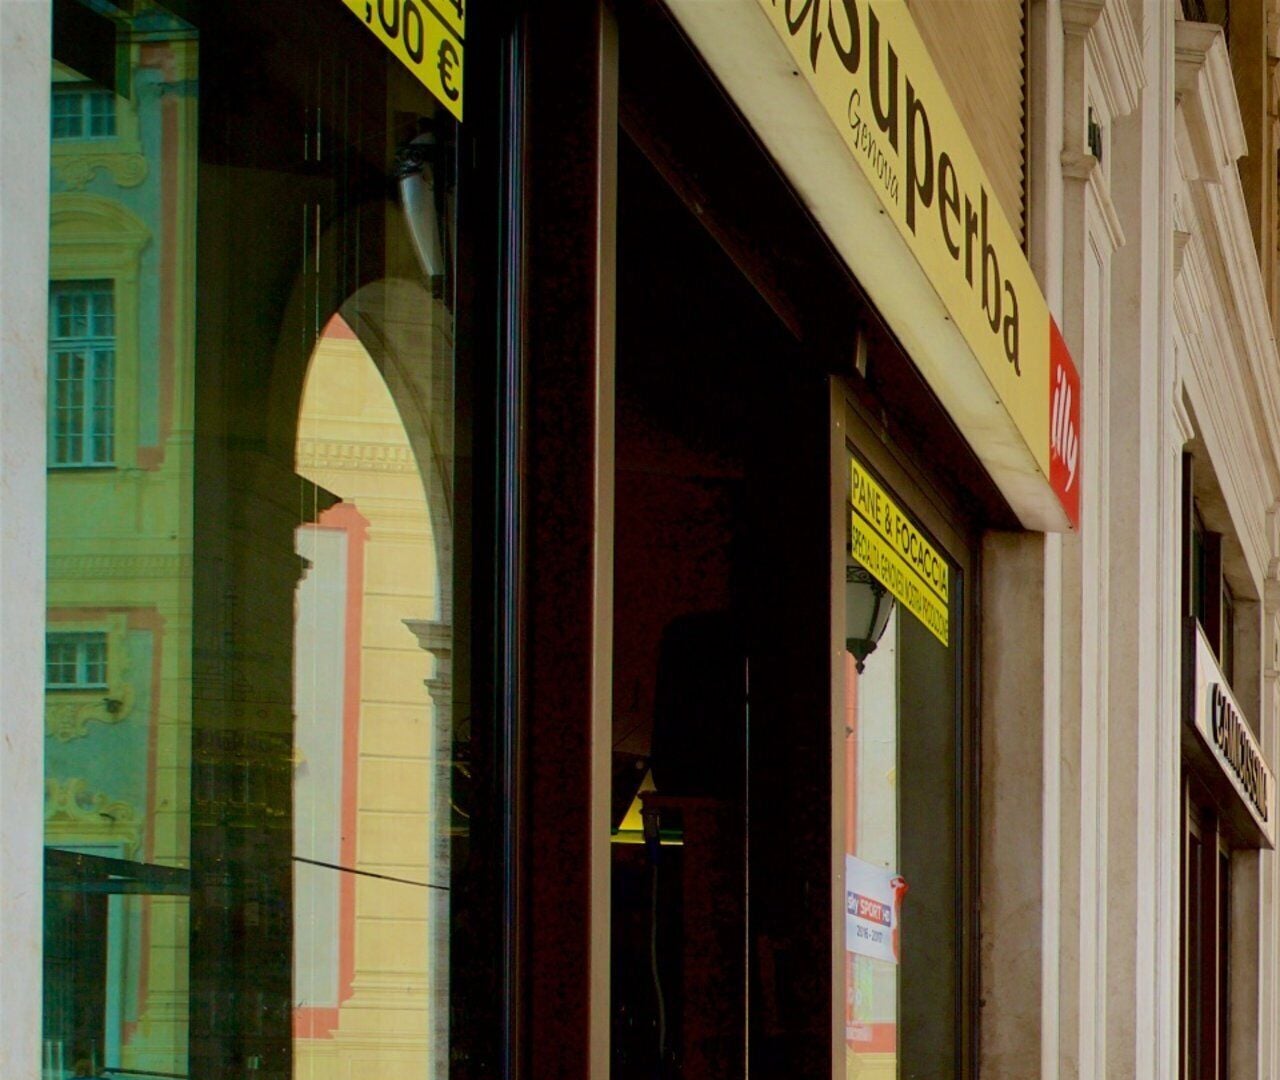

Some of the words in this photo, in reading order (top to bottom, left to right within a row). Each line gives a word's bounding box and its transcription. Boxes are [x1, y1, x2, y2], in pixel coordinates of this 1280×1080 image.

[847, 88, 900, 206] Genova
[1050, 364, 1077, 493] illy
[852, 466, 881, 526] PANE
[885, 503, 893, 536] &
[896, 517, 948, 590] FOCACCIA
[860, 897, 882, 922] SPORT
